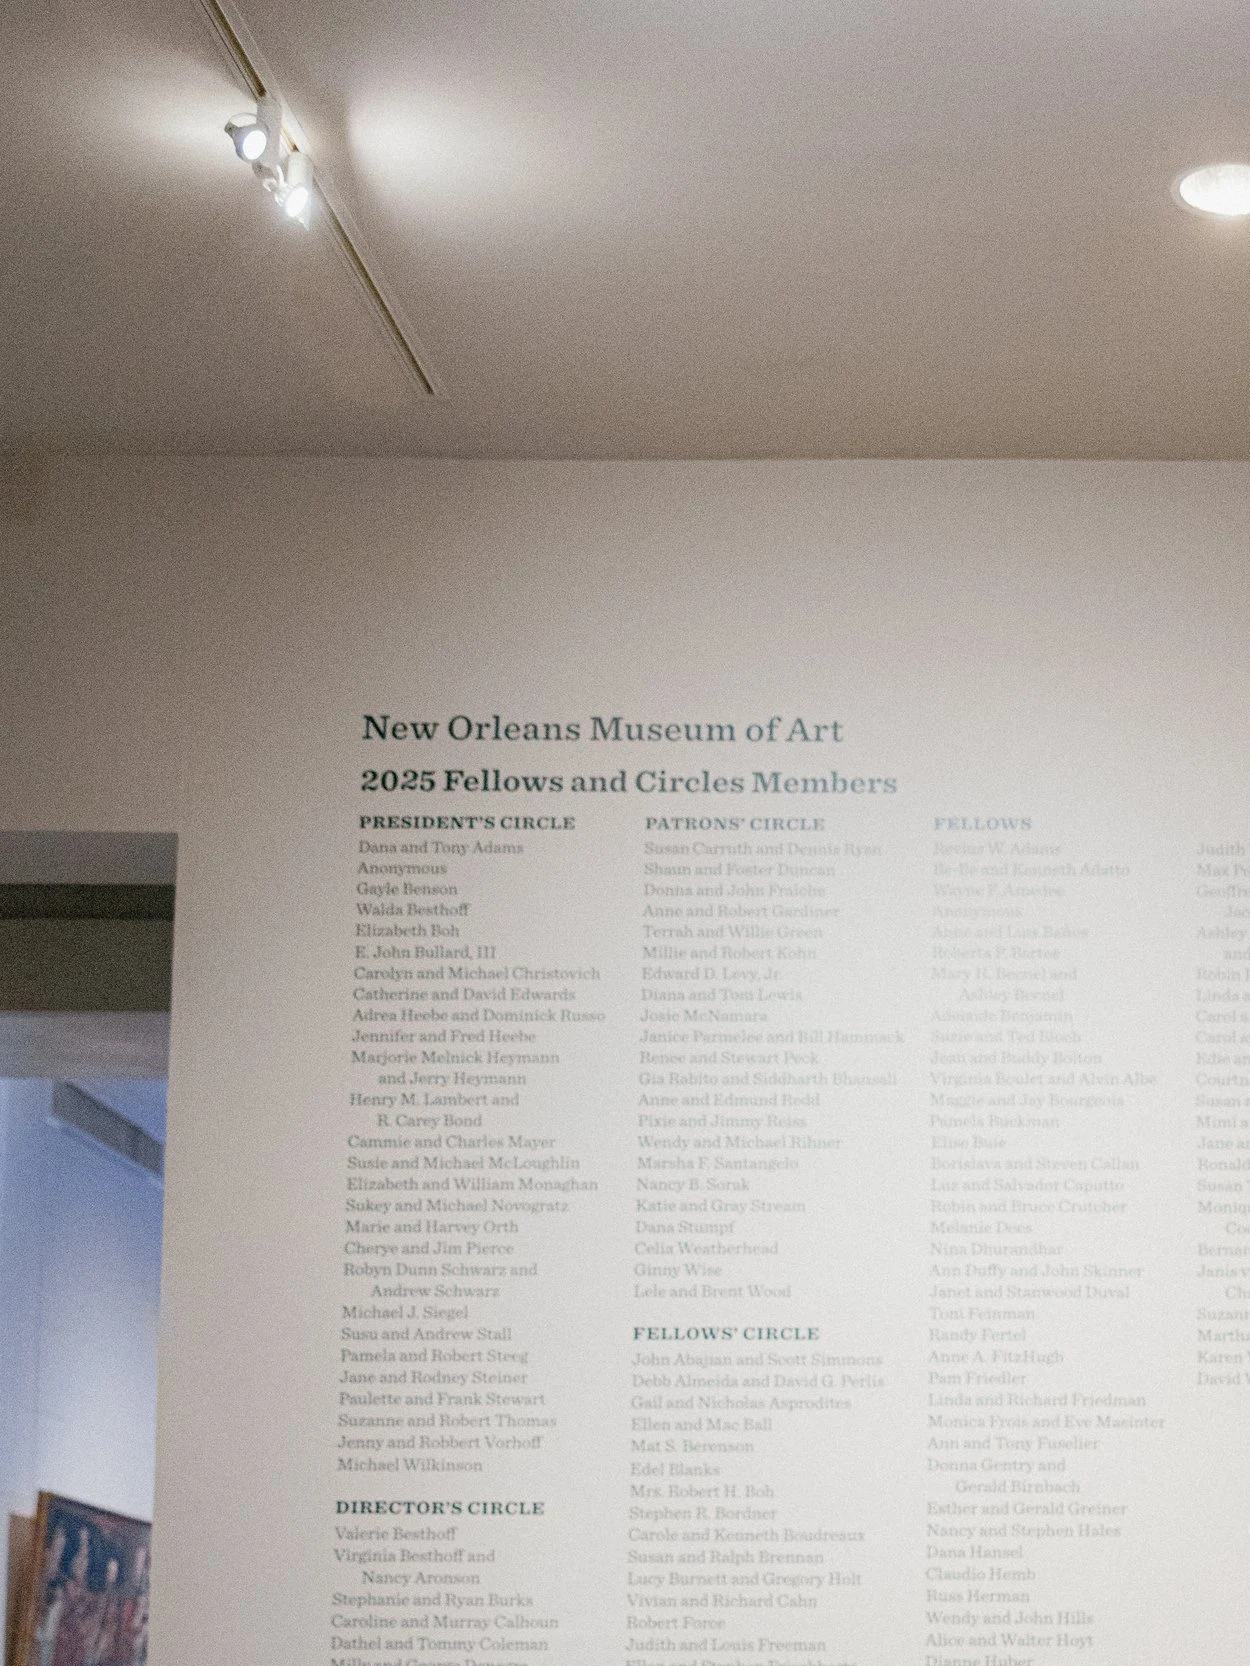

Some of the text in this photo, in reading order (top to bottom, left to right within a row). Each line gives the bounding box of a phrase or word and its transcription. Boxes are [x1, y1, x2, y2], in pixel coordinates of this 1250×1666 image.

[362, 715, 842, 743] New Orleans Museum of Art
[360, 768, 897, 794] 2025 Fellows and Circles Members
[358, 816, 576, 830] PRESIDENT'S CIRCLE
[644, 817, 825, 831] PATRONS' CIRCLE
[933, 817, 1033, 830] FELLOWS
[357, 841, 525, 858] Dana and Tony Adams
[356, 862, 448, 879] Anonymous
[355, 882, 459, 899] Gayle Benson
[355, 903, 470, 916] Walda Besthoff
[354, 924, 460, 937] Elizabeth Boh
[372, 946, 411, 959] John
[414, 946, 473, 962] Bullard,
[476, 946, 497, 959] III
[352, 967, 601, 984] Carolyn and Michael Christovich
[351, 988, 576, 1002] Catherine and David Edwards
[352, 1009, 606, 1022] Adrea Heebe and Dominick Russo
[351, 1030, 537, 1043] Jennifer and Fred Heebe
[346, 1178, 599, 1196] Elizabeth and William Monaghan
[341, 1306, 405, 1318] Michael
[422, 1306, 469, 1323] Siegel
[632, 1327, 820, 1341] FELLOWS' CIRCLE
[674, 1419, 703, 1431] and
[336, 1459, 484, 1472] Michael Wilkinson
[335, 1502, 545, 1515] DIRECTOR'S CIRCLE
[982, 1612, 1012, 1625] and
